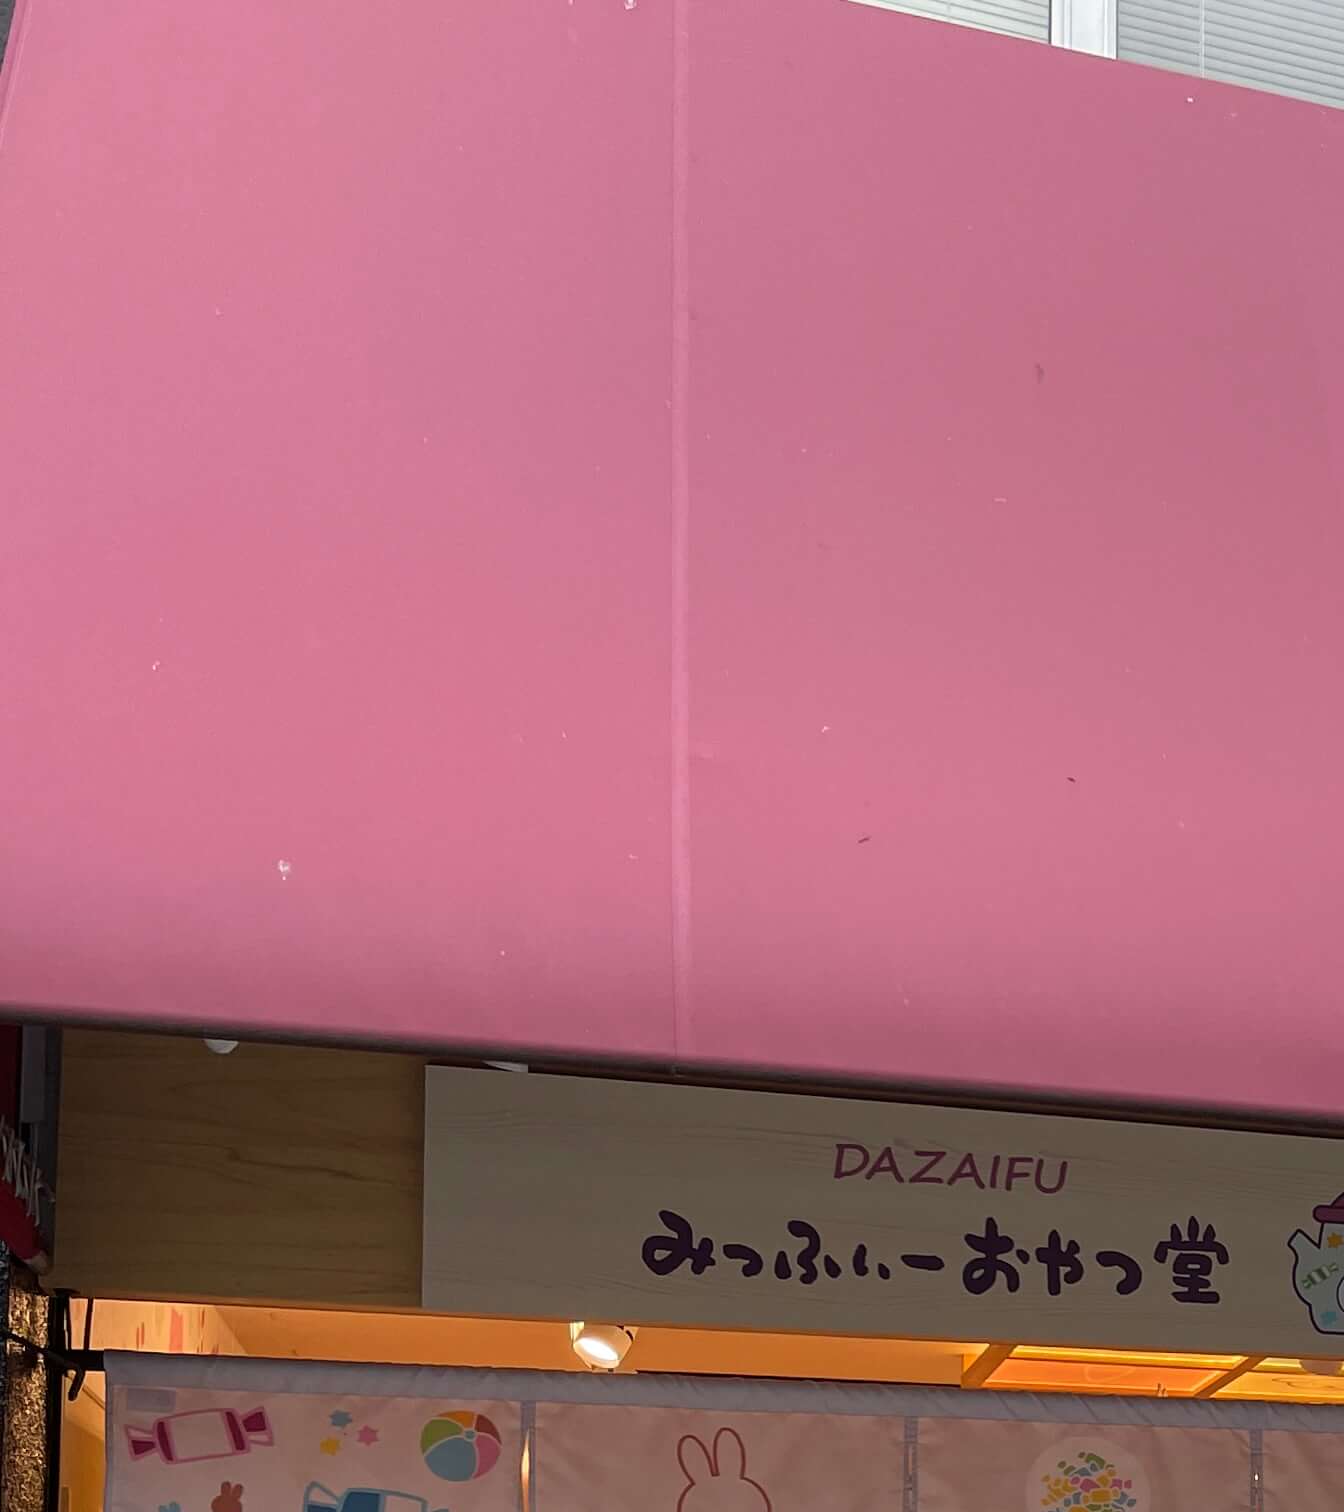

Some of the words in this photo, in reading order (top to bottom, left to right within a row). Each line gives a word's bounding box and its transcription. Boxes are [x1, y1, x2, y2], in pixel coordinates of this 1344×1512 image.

[833, 1142, 1069, 1195] DAZAIFU
[641, 1208, 1230, 1305] みっふぃーおやつ堂
